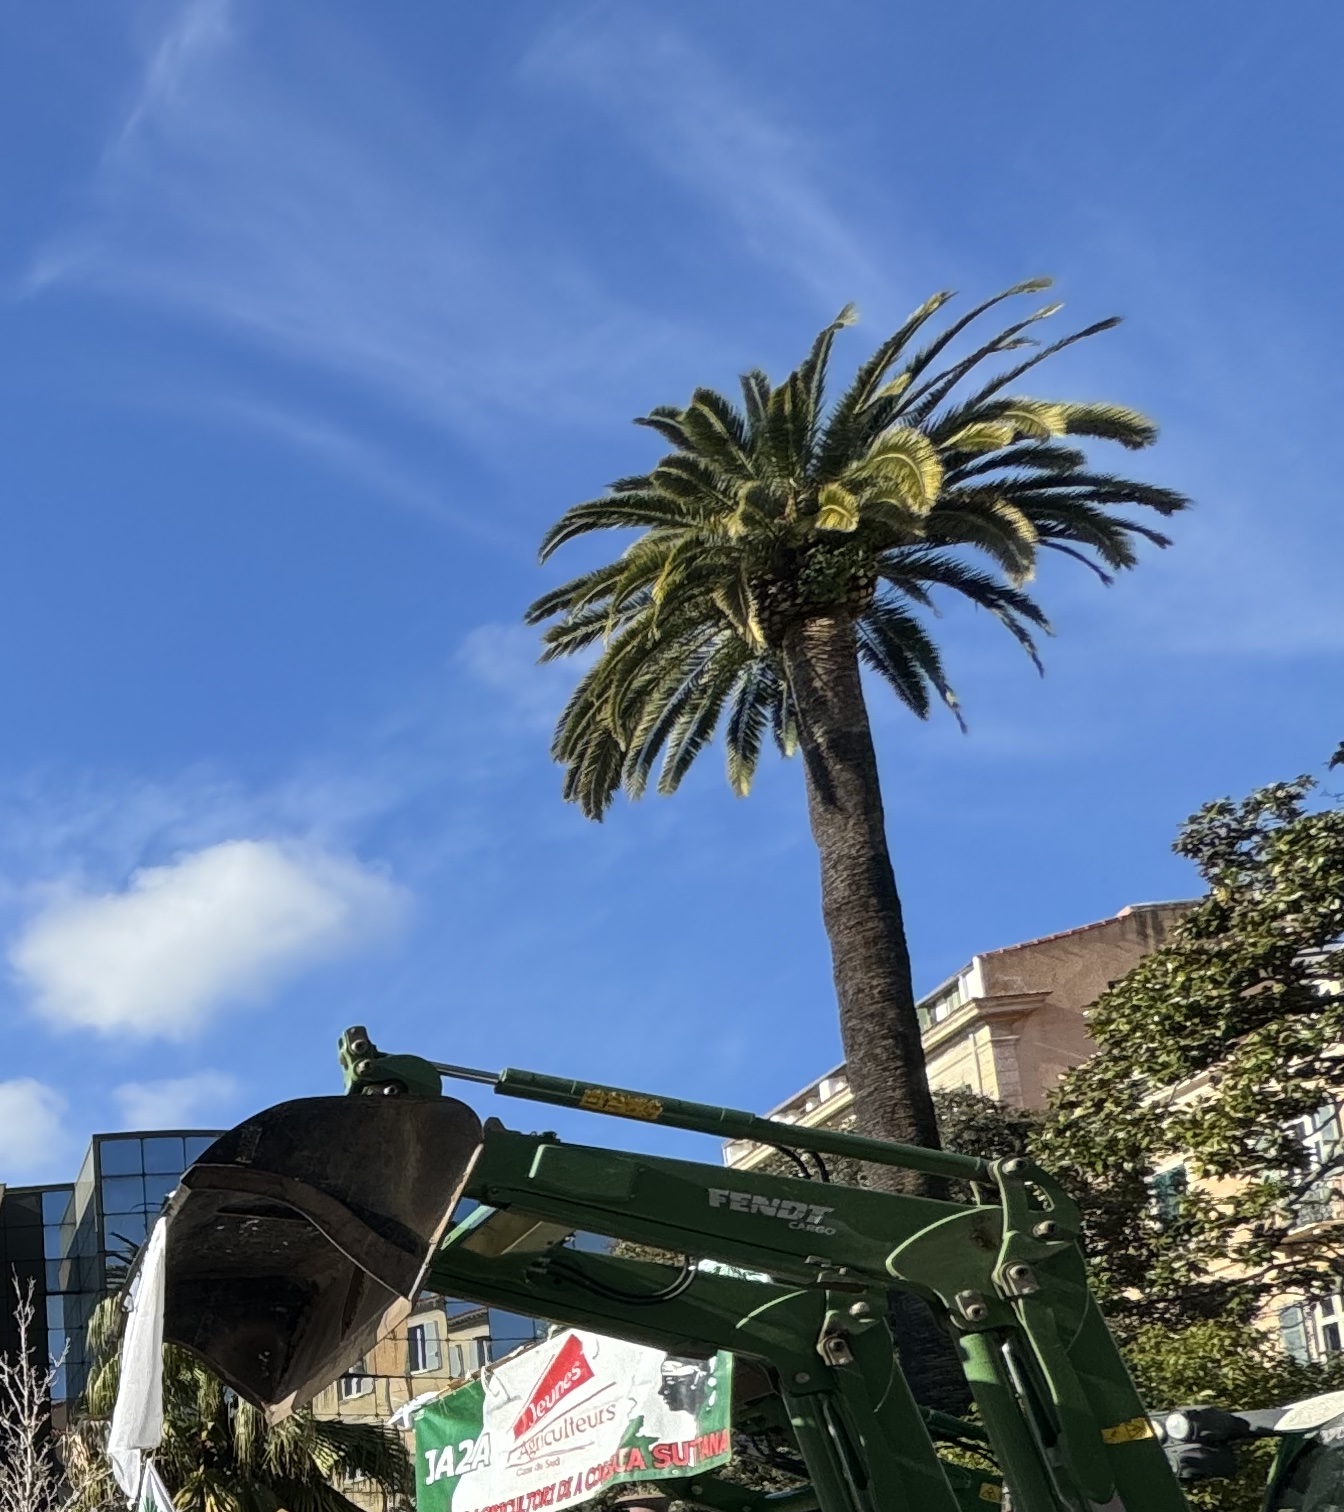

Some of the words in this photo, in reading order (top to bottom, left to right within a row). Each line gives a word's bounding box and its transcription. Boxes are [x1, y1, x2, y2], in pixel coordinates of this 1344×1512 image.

[708, 1188, 835, 1224] FENDT
[788, 1221, 837, 1236] CARGO
[526, 1361, 582, 1427] Jeunes
[424, 1431, 491, 1486] JA2A
[516, 1404, 616, 1461] Agriculteurs
